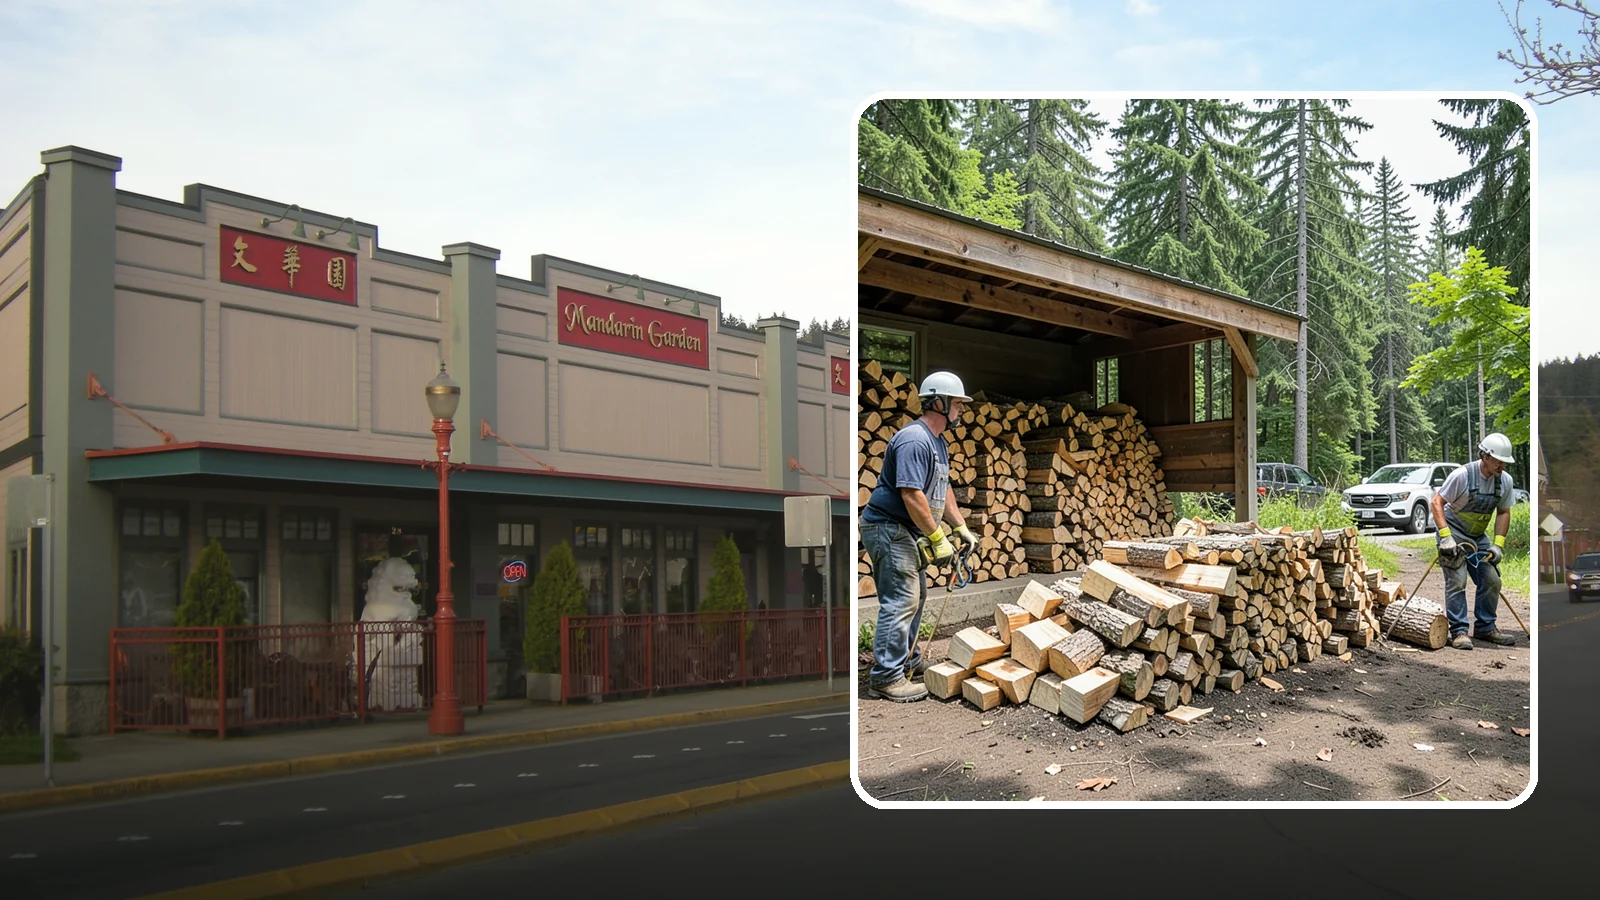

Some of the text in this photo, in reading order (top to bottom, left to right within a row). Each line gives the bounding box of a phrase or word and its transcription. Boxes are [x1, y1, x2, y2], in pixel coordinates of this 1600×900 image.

[230, 235, 346, 291] 文華園
[564, 302, 701, 352] Mandarin Garden
[503, 565, 527, 578] OPEN
